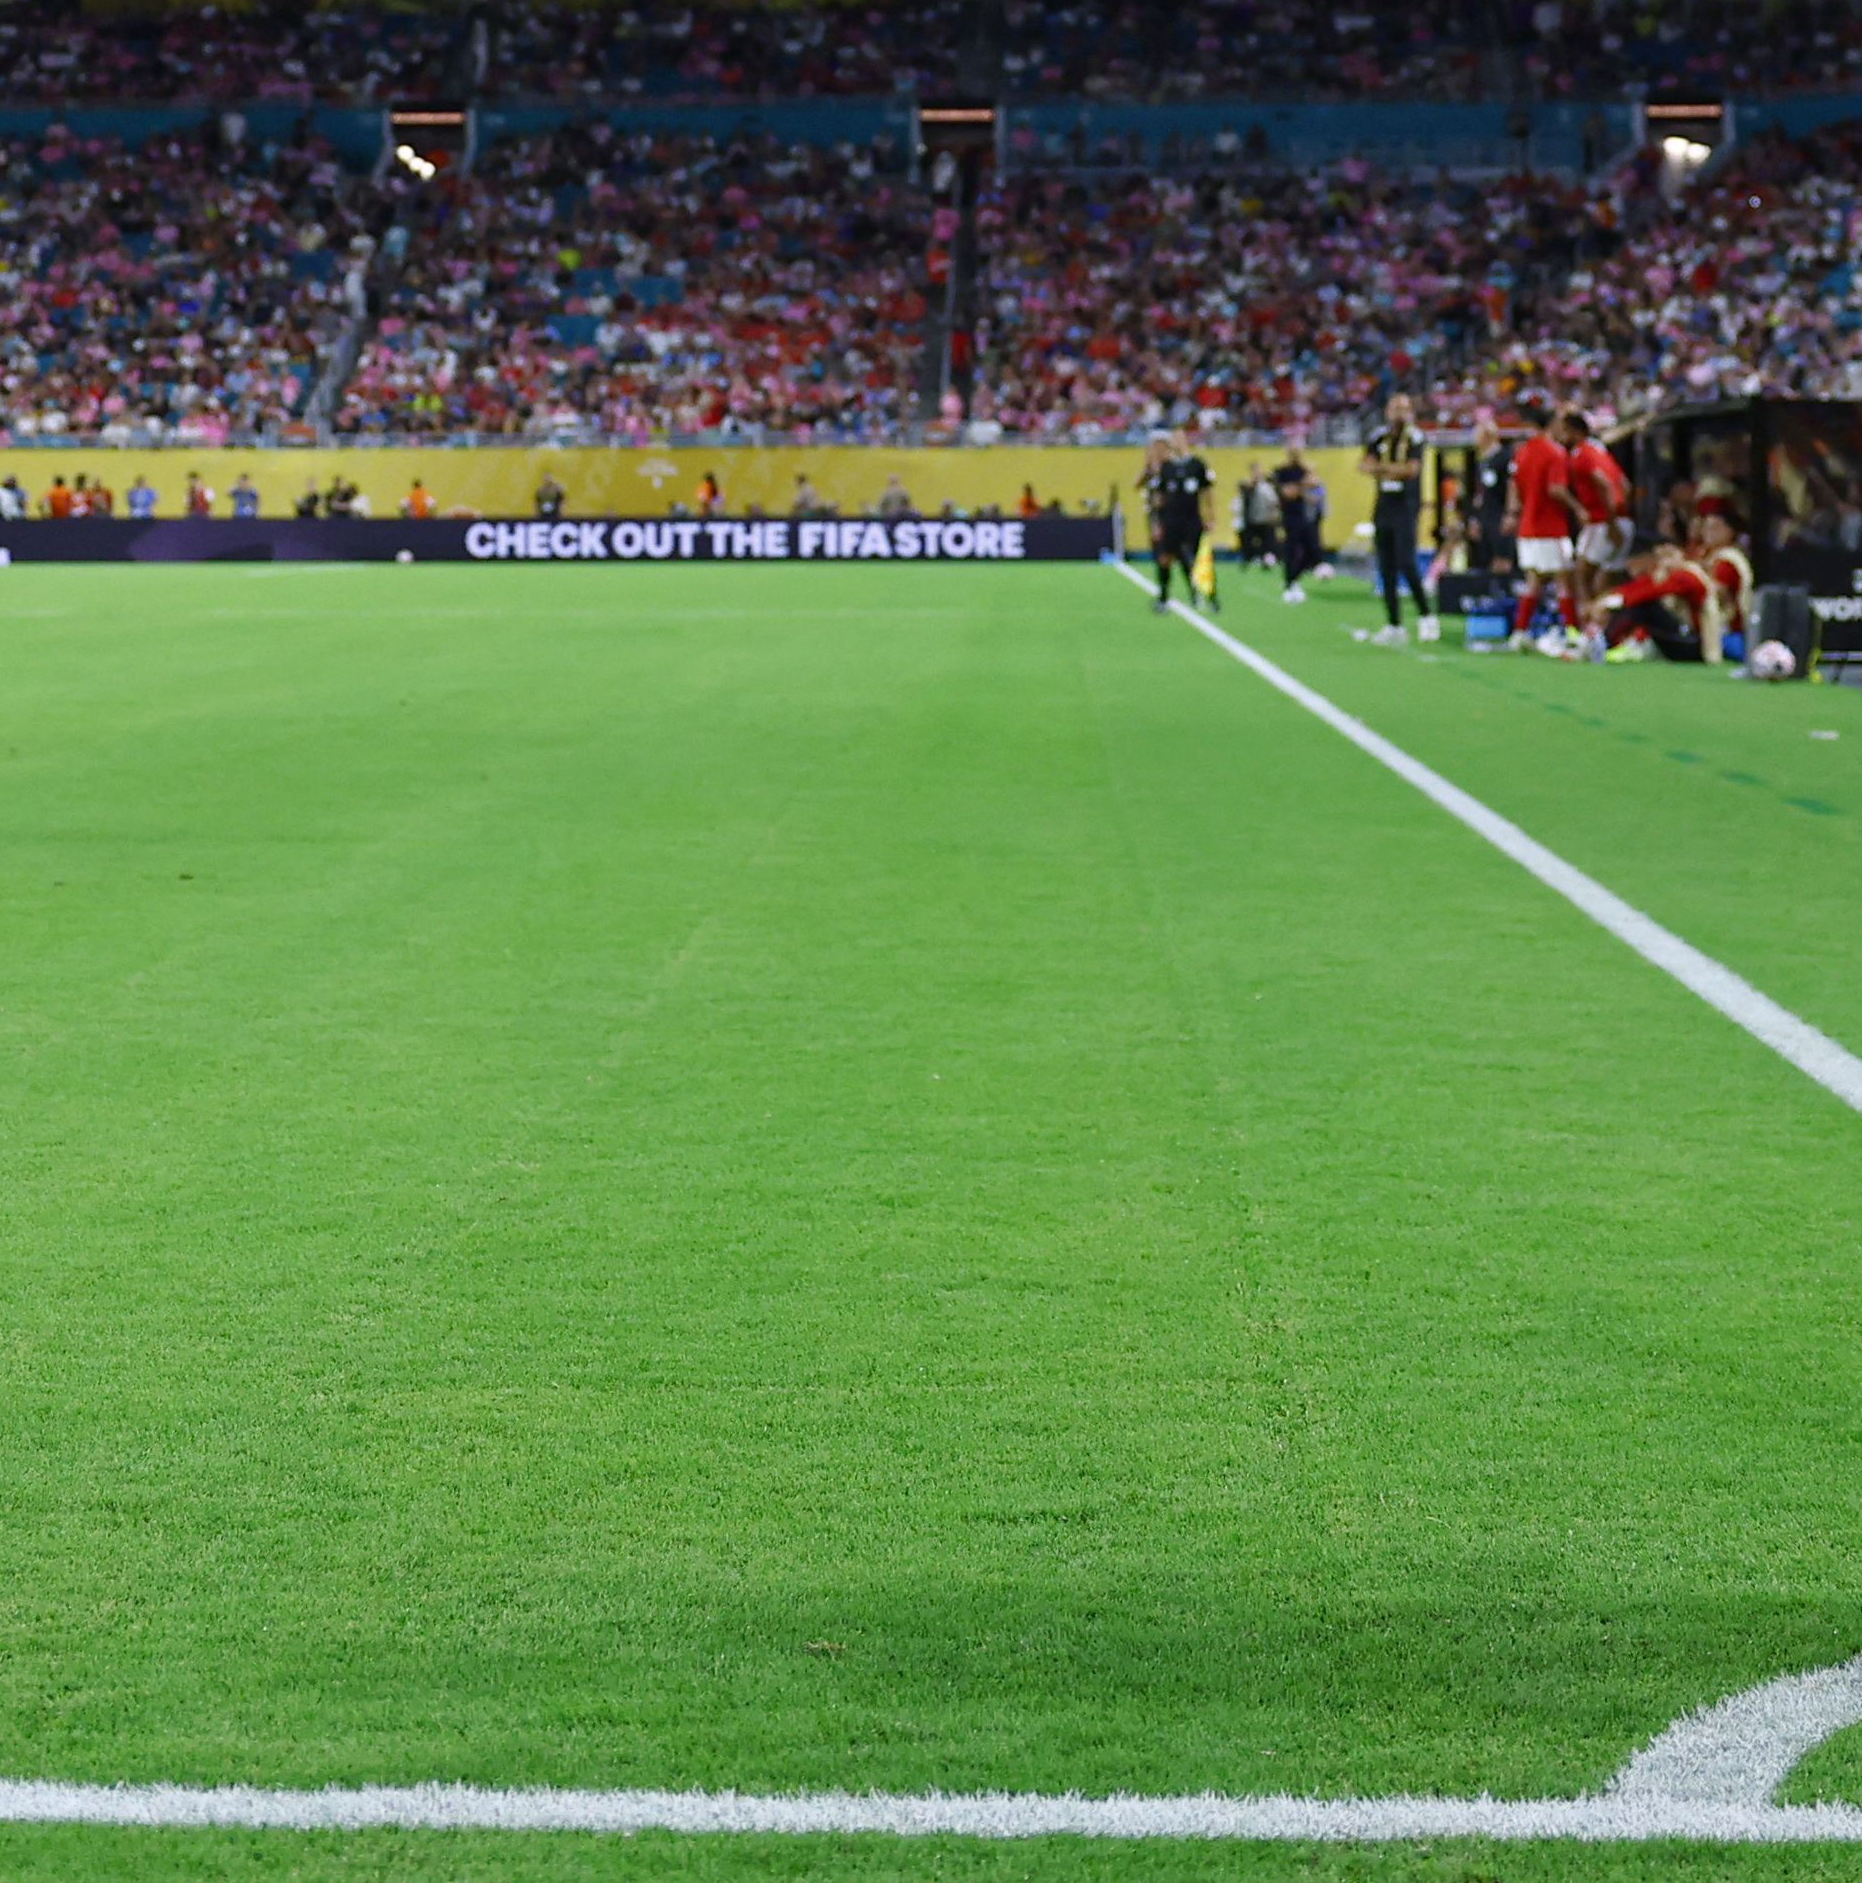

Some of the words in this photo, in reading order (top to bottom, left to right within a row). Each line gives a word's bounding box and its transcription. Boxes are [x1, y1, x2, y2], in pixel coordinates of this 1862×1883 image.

[465, 521, 608, 559] CHECK
[612, 521, 708, 559] OUT
[705, 521, 789, 558] THE
[800, 521, 894, 558] FIFA
[894, 521, 1026, 558] STORE
